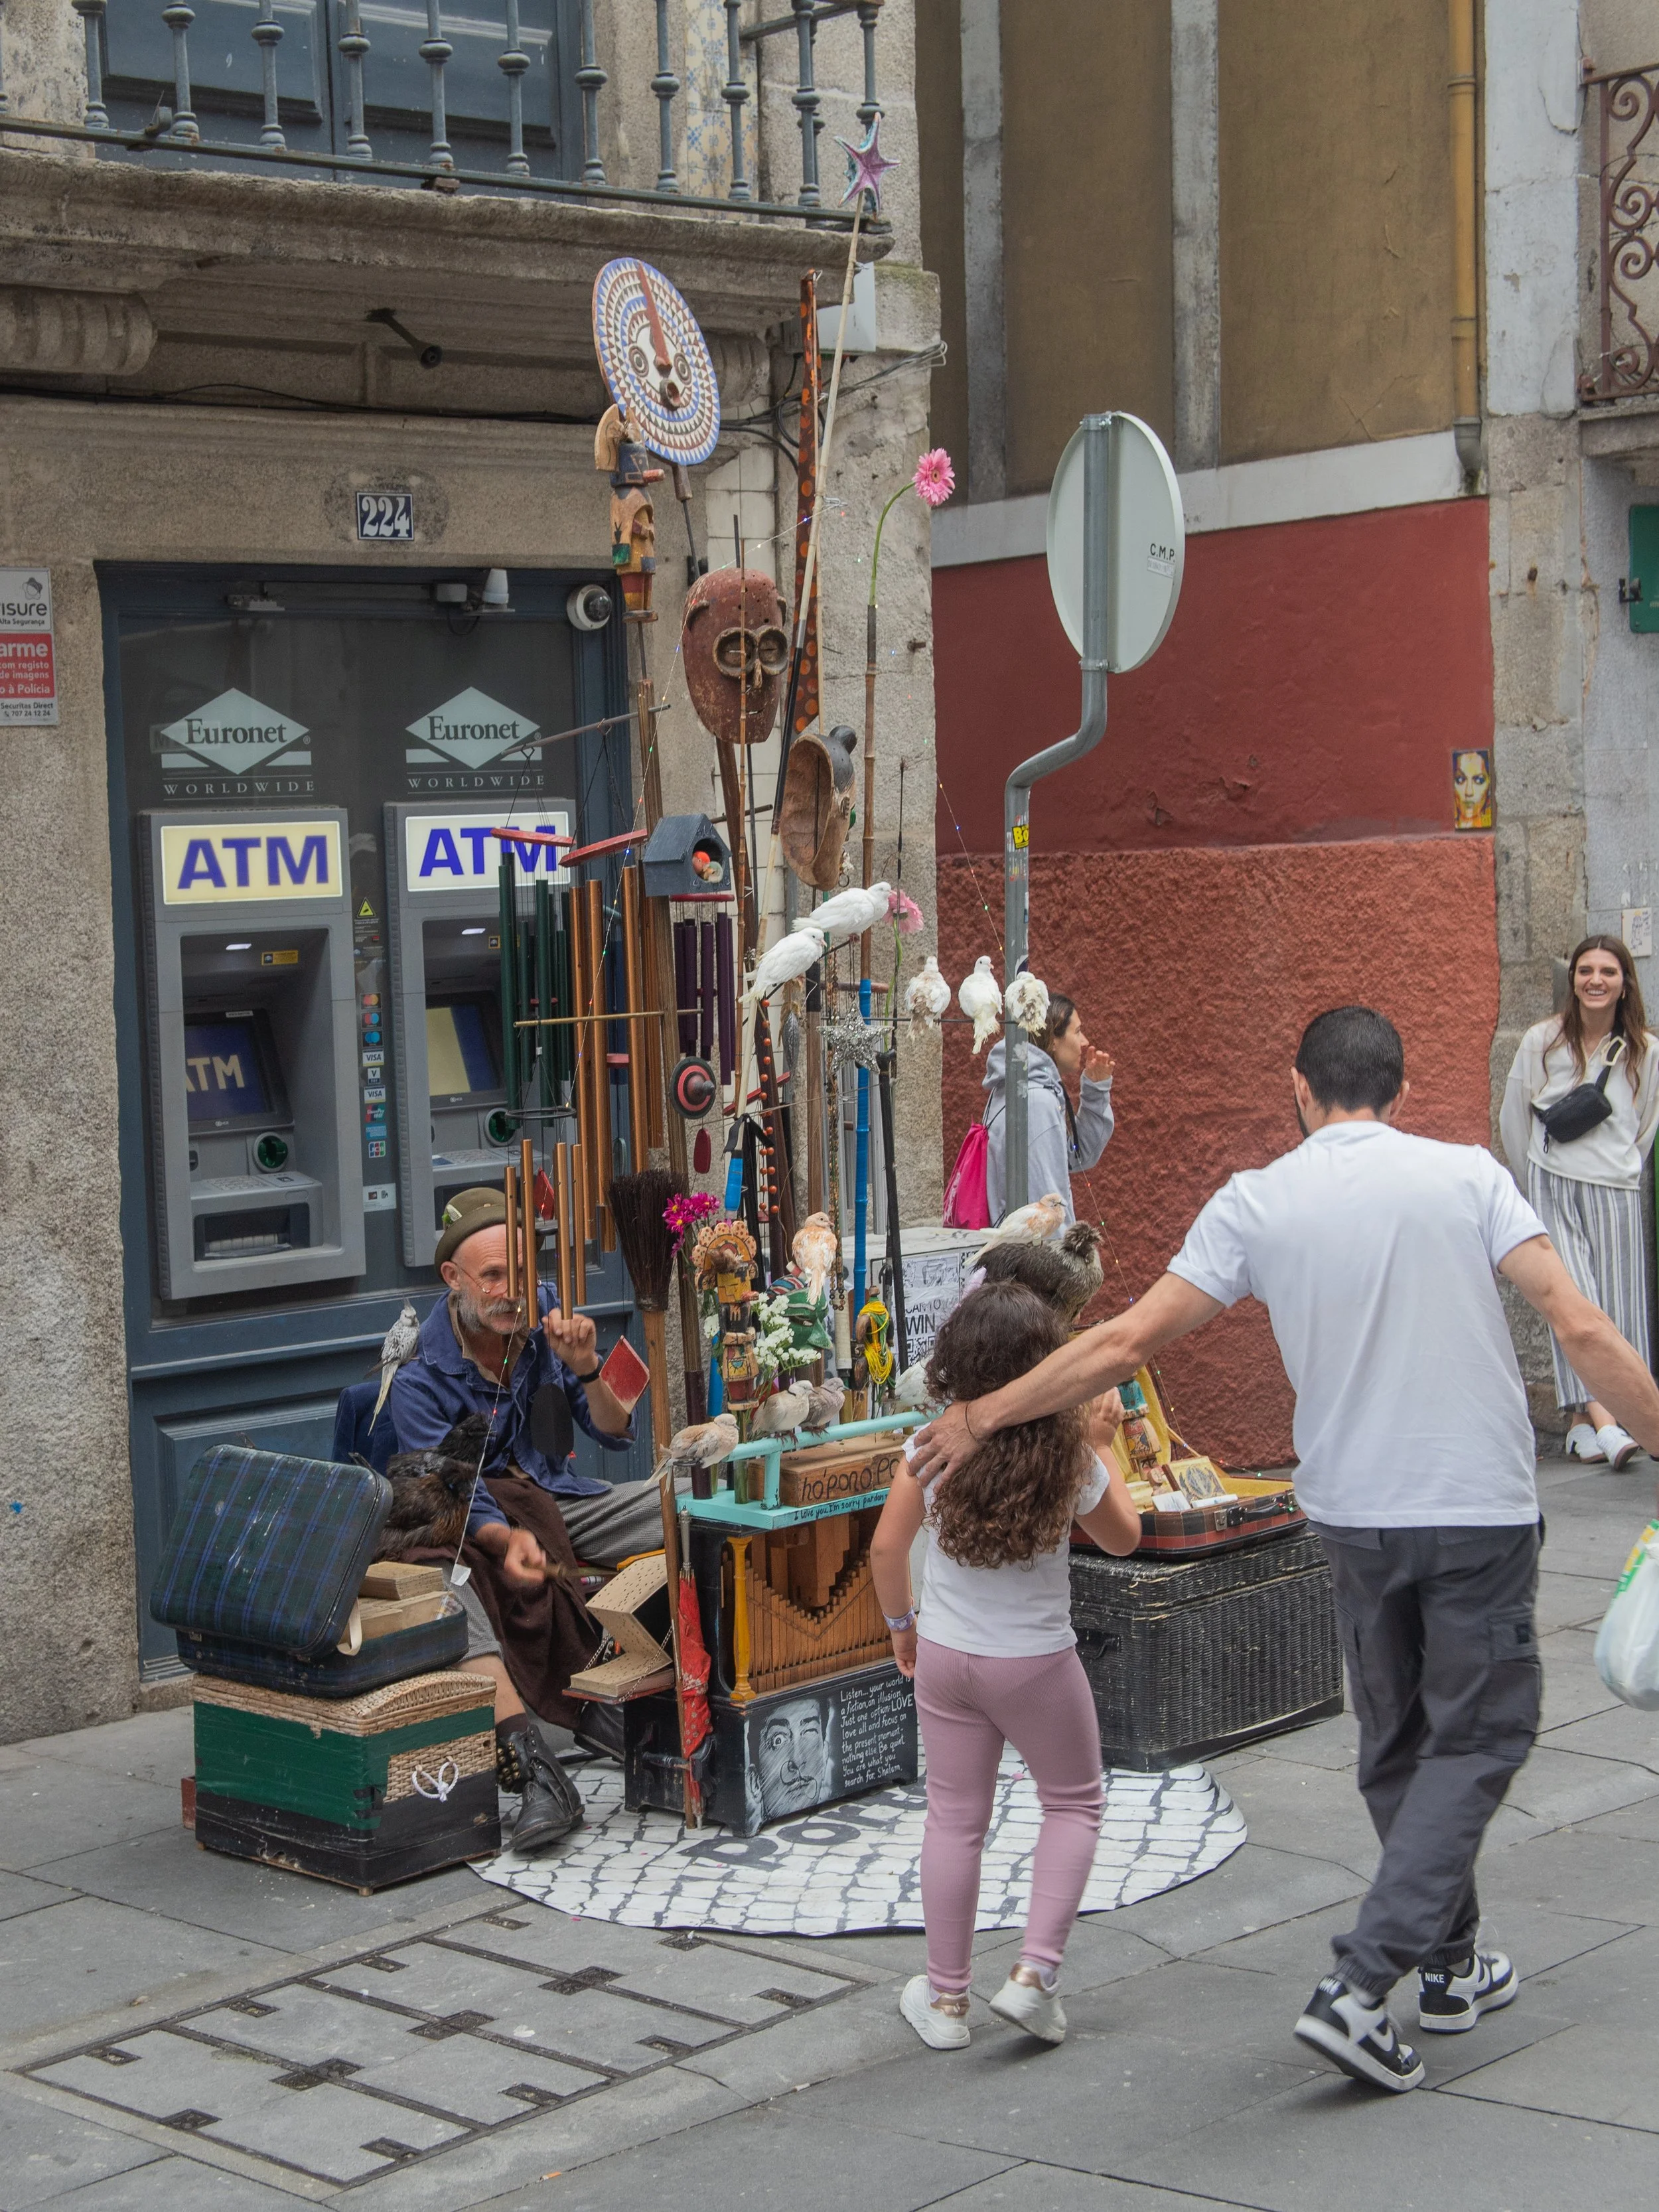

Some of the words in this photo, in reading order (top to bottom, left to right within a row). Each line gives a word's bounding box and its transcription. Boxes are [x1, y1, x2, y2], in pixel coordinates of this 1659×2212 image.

[361, 496, 410, 538] 224
[1150, 543, 1175, 563] C.M.P.
[13, 618, 45, 627] Segurança
[13, 670, 49, 681] imagens
[19, 660, 49, 672] registo
[18, 683, 50, 694] Polícia
[184, 718, 287, 745] Euronet
[427, 715, 520, 741] Euronet
[163, 780, 315, 795] WORLDWIDE
[407, 774, 545, 788] WORLDWIDE
[419, 824, 557, 878] ATM
[177, 834, 329, 890] ATM
[371, 1069, 377, 1078] V
[368, 1090, 382, 1098] VISA
[905, 1313, 935, 1336] WIN
[801, 1509, 814, 1518] love
[841, 1500, 859, 1509] sorry
[863, 1493, 884, 1507] pardon
[869, 1682, 885, 1698] your
[886, 1674, 904, 1688] world
[840, 1713, 856, 1728] Just
[857, 1712, 868, 1722] one
[891, 1693, 914, 1712] LOVE
[842, 1729, 857, 1740] love
[858, 1722, 867, 1735] all
[868, 1716, 881, 1732] and
[881, 1714, 899, 1728] focus
[899, 1713, 907, 1722] on
[841, 1740, 853, 1754] the
[854, 1732, 877, 1754] present
[841, 1751, 865, 1764] nothing
[878, 1741, 889, 1754] Be
[889, 1733, 906, 1753] quiet
[855, 1763, 866, 1773] are
[867, 1753, 883, 1767] what
[885, 1753, 896, 1767] you
[844, 1773, 864, 1788] search
[1425, 1972, 1445, 1984] NIKE
